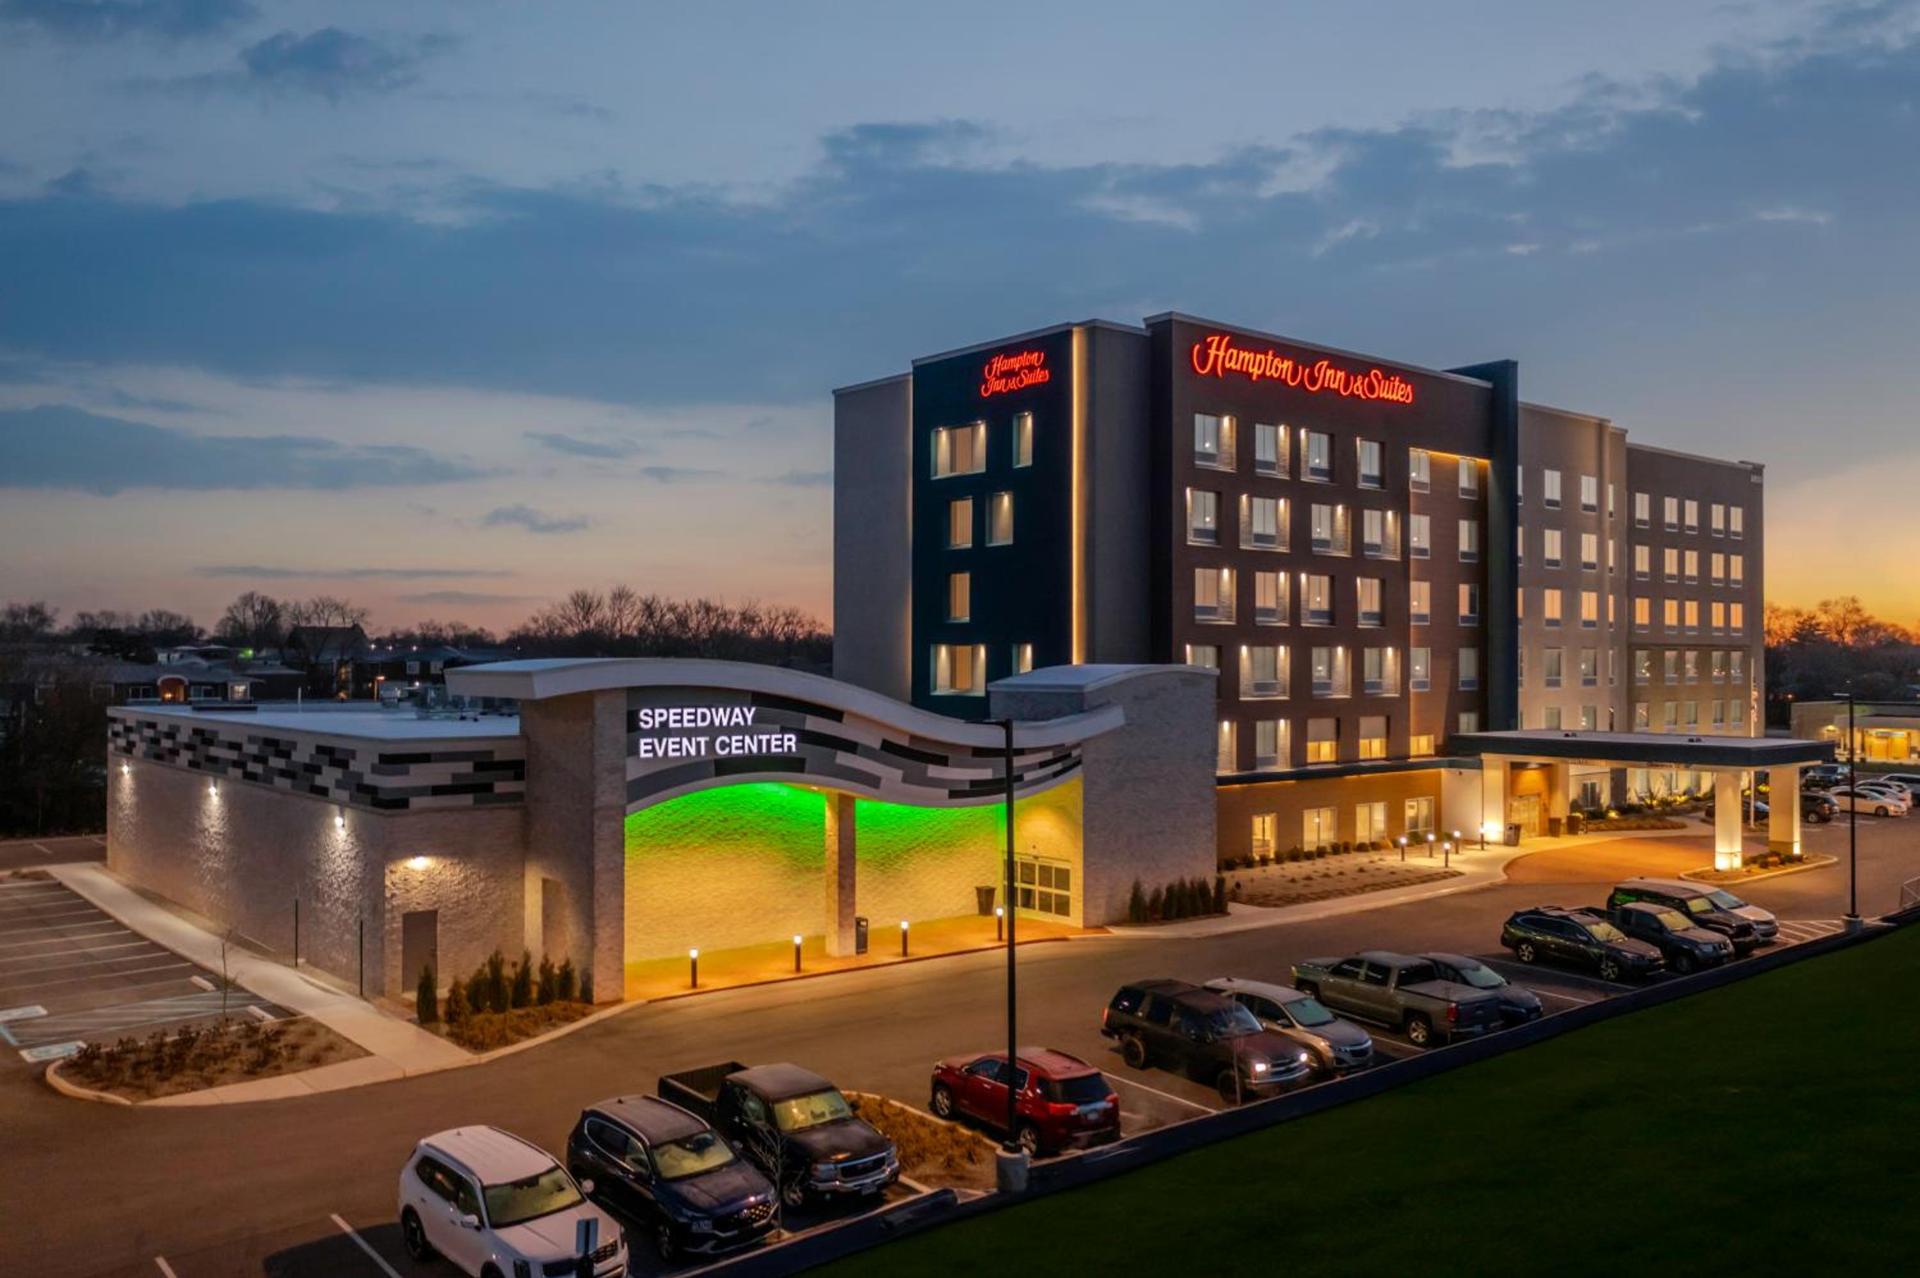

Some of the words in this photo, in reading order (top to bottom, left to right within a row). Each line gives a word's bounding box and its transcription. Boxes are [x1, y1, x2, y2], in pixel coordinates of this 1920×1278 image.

[984, 351, 1044, 379] Hampton
[1193, 335, 1302, 387] Hampton
[1304, 360, 1354, 396] Inn
[1364, 369, 1413, 403] Suites
[981, 377, 1009, 397] Inn
[1016, 367, 1049, 388] Suites
[639, 707, 756, 728] SPEEDWAY
[639, 737, 709, 758] EVENT
[715, 734, 797, 755] CENTER
